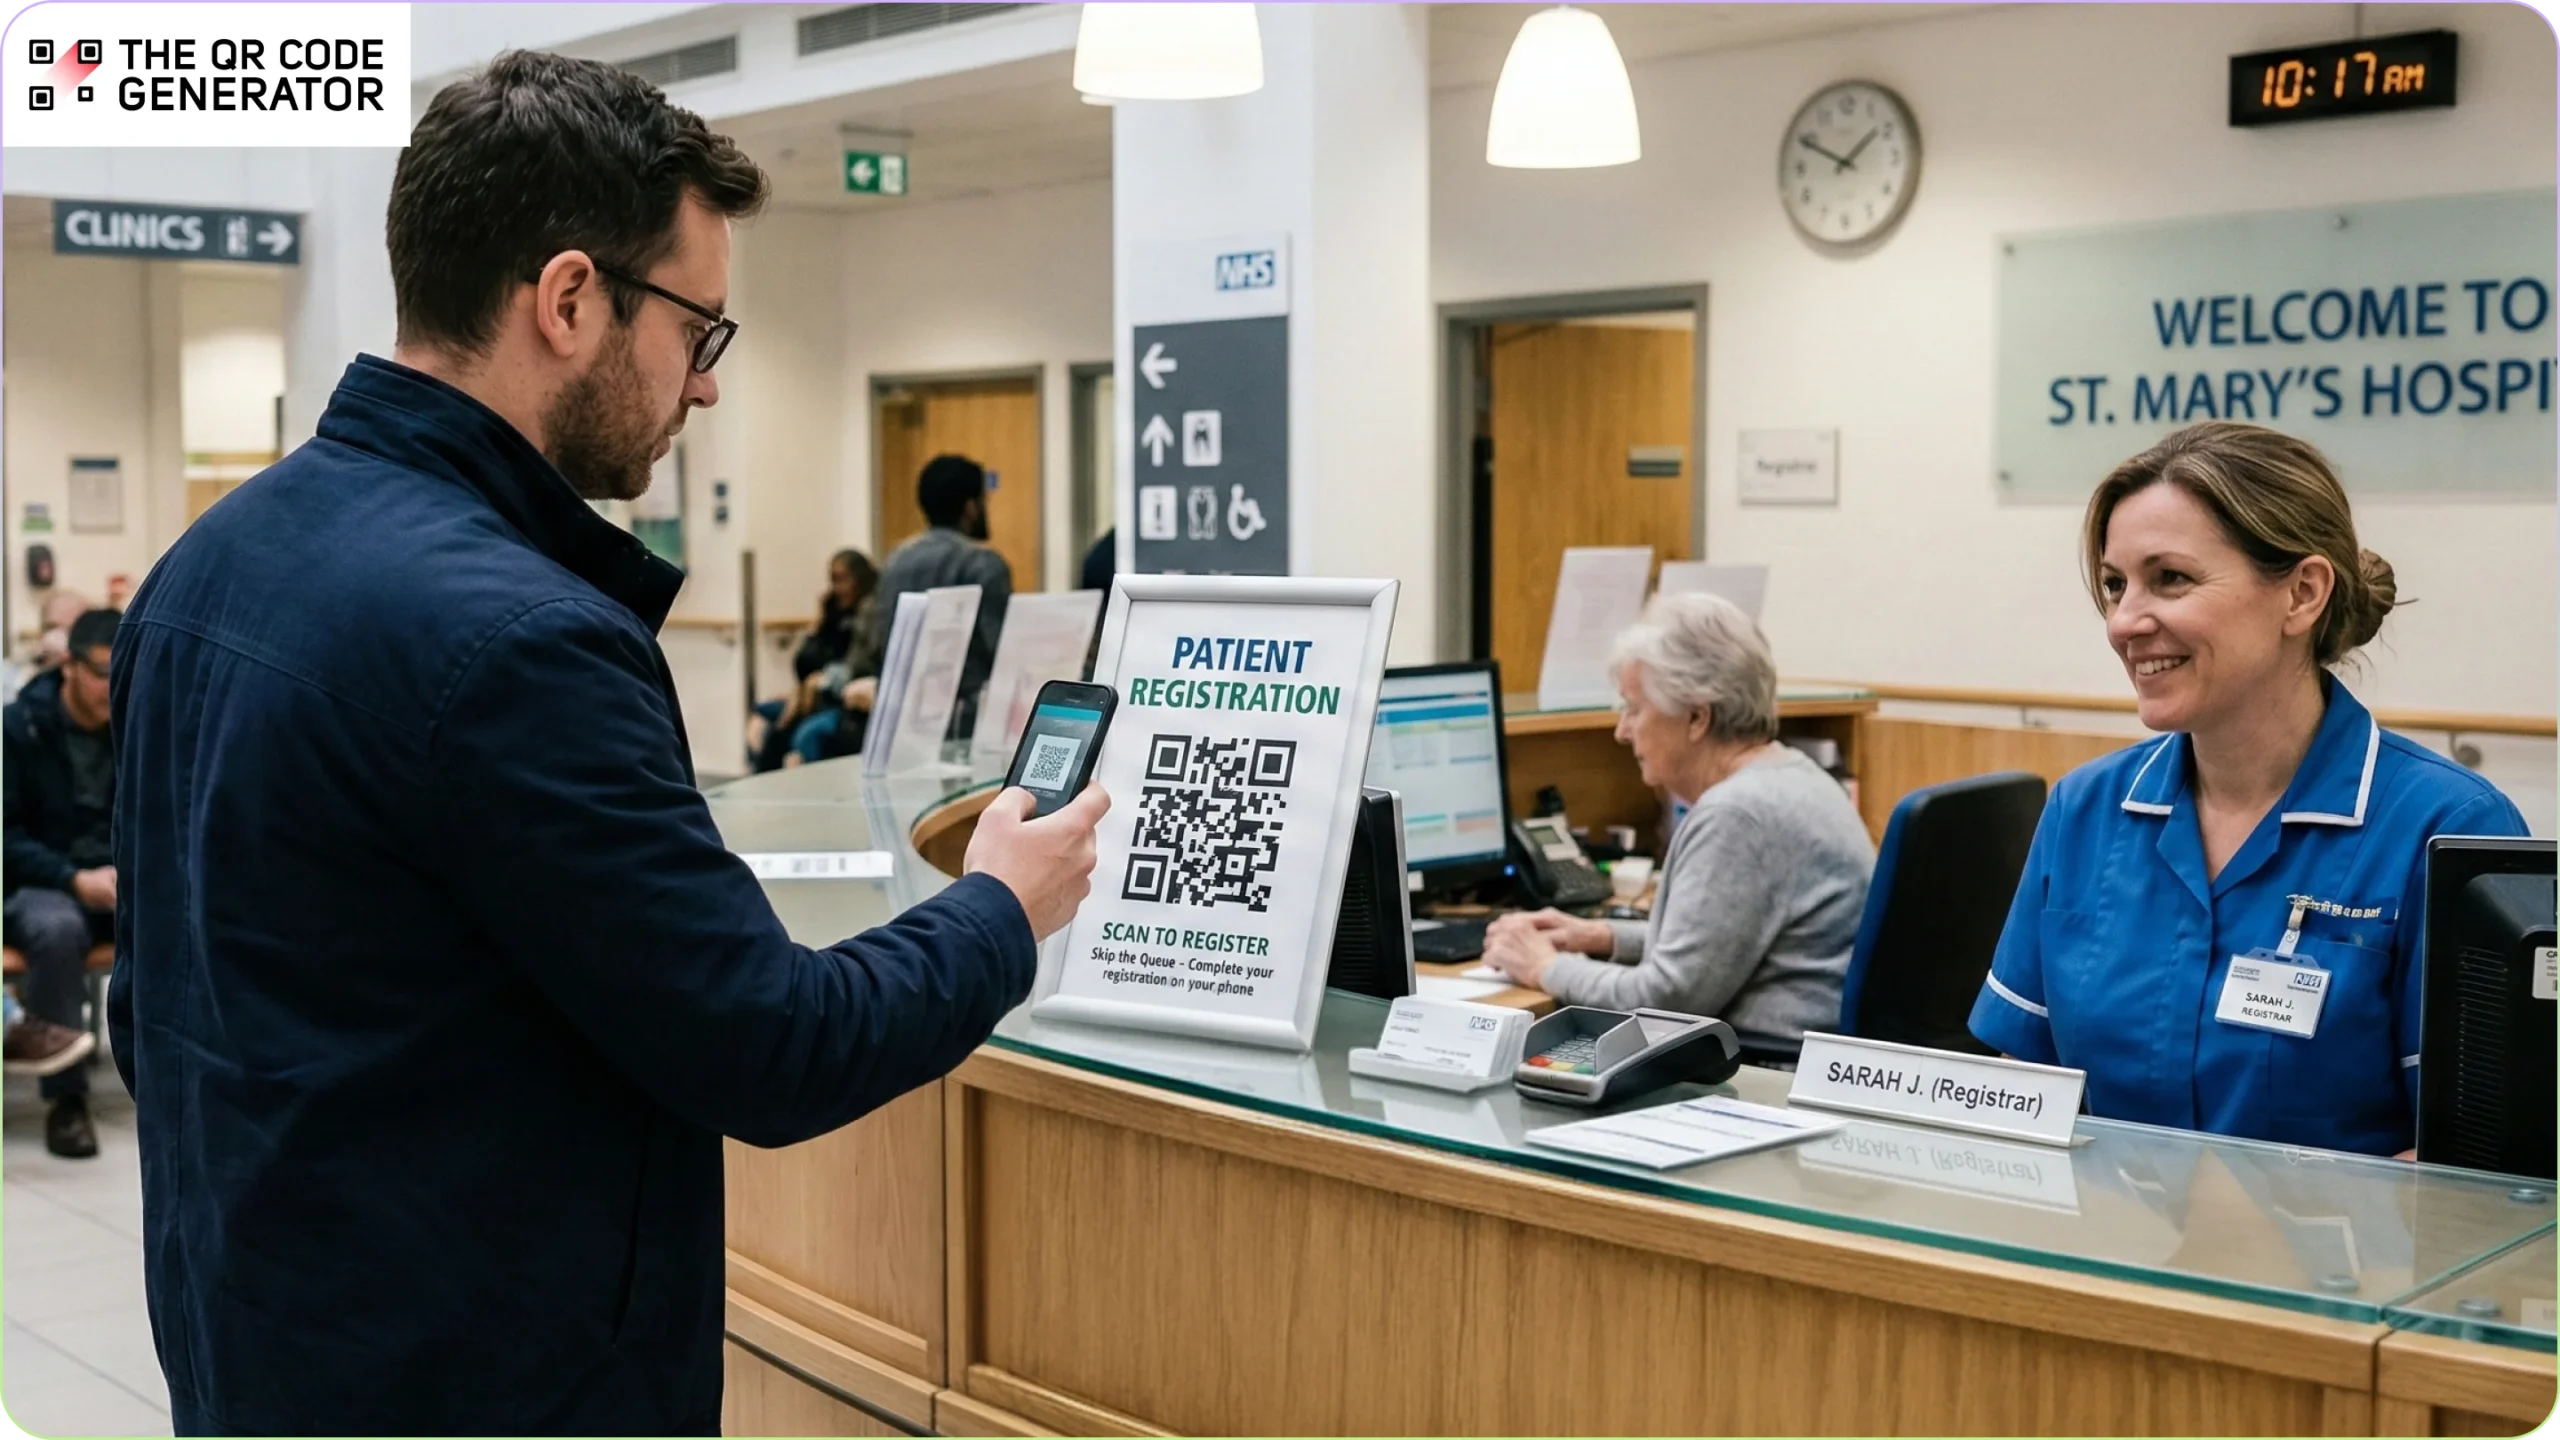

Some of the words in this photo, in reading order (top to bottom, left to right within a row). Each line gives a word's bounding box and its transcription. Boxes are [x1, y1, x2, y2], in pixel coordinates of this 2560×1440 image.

[2262, 51, 2377, 107] 10:17
[2382, 63, 2425, 94] AM
[64, 210, 205, 252] CLINICS
[1215, 251, 1275, 290] NHS
[2153, 283, 2447, 349] WELCOME
[2462, 277, 2549, 333] TO
[2048, 376, 2116, 426] ST.
[2132, 366, 2343, 422] MARY'S
[2362, 358, 2558, 416] HOSPI
[1171, 636, 1313, 674] PATIENT
[1128, 677, 1341, 715] REGISTRATION
[1102, 922, 1150, 944] SCAN
[1155, 927, 1177, 947] TO
[1182, 930, 1269, 956] REGISTER
[1090, 947, 1115, 964] Skip
[1118, 950, 1136, 964] the
[1140, 952, 1176, 968] Queue
[1188, 958, 1244, 976] Complete
[1246, 966, 1274, 980] your
[1102, 968, 1167, 985] registration
[1170, 976, 1185, 987] on
[1187, 978, 1215, 992] your
[1217, 980, 1254, 996] phone
[2241, 1006, 2292, 1023] REGISTRAR
[2245, 992, 2283, 1007] SARAH
[2285, 1000, 2294, 1010] J.
[1826, 1061, 1903, 1092] SARAH
[1907, 1075, 1924, 1096] J.
[1931, 1077, 2043, 1119] (Registrar)
